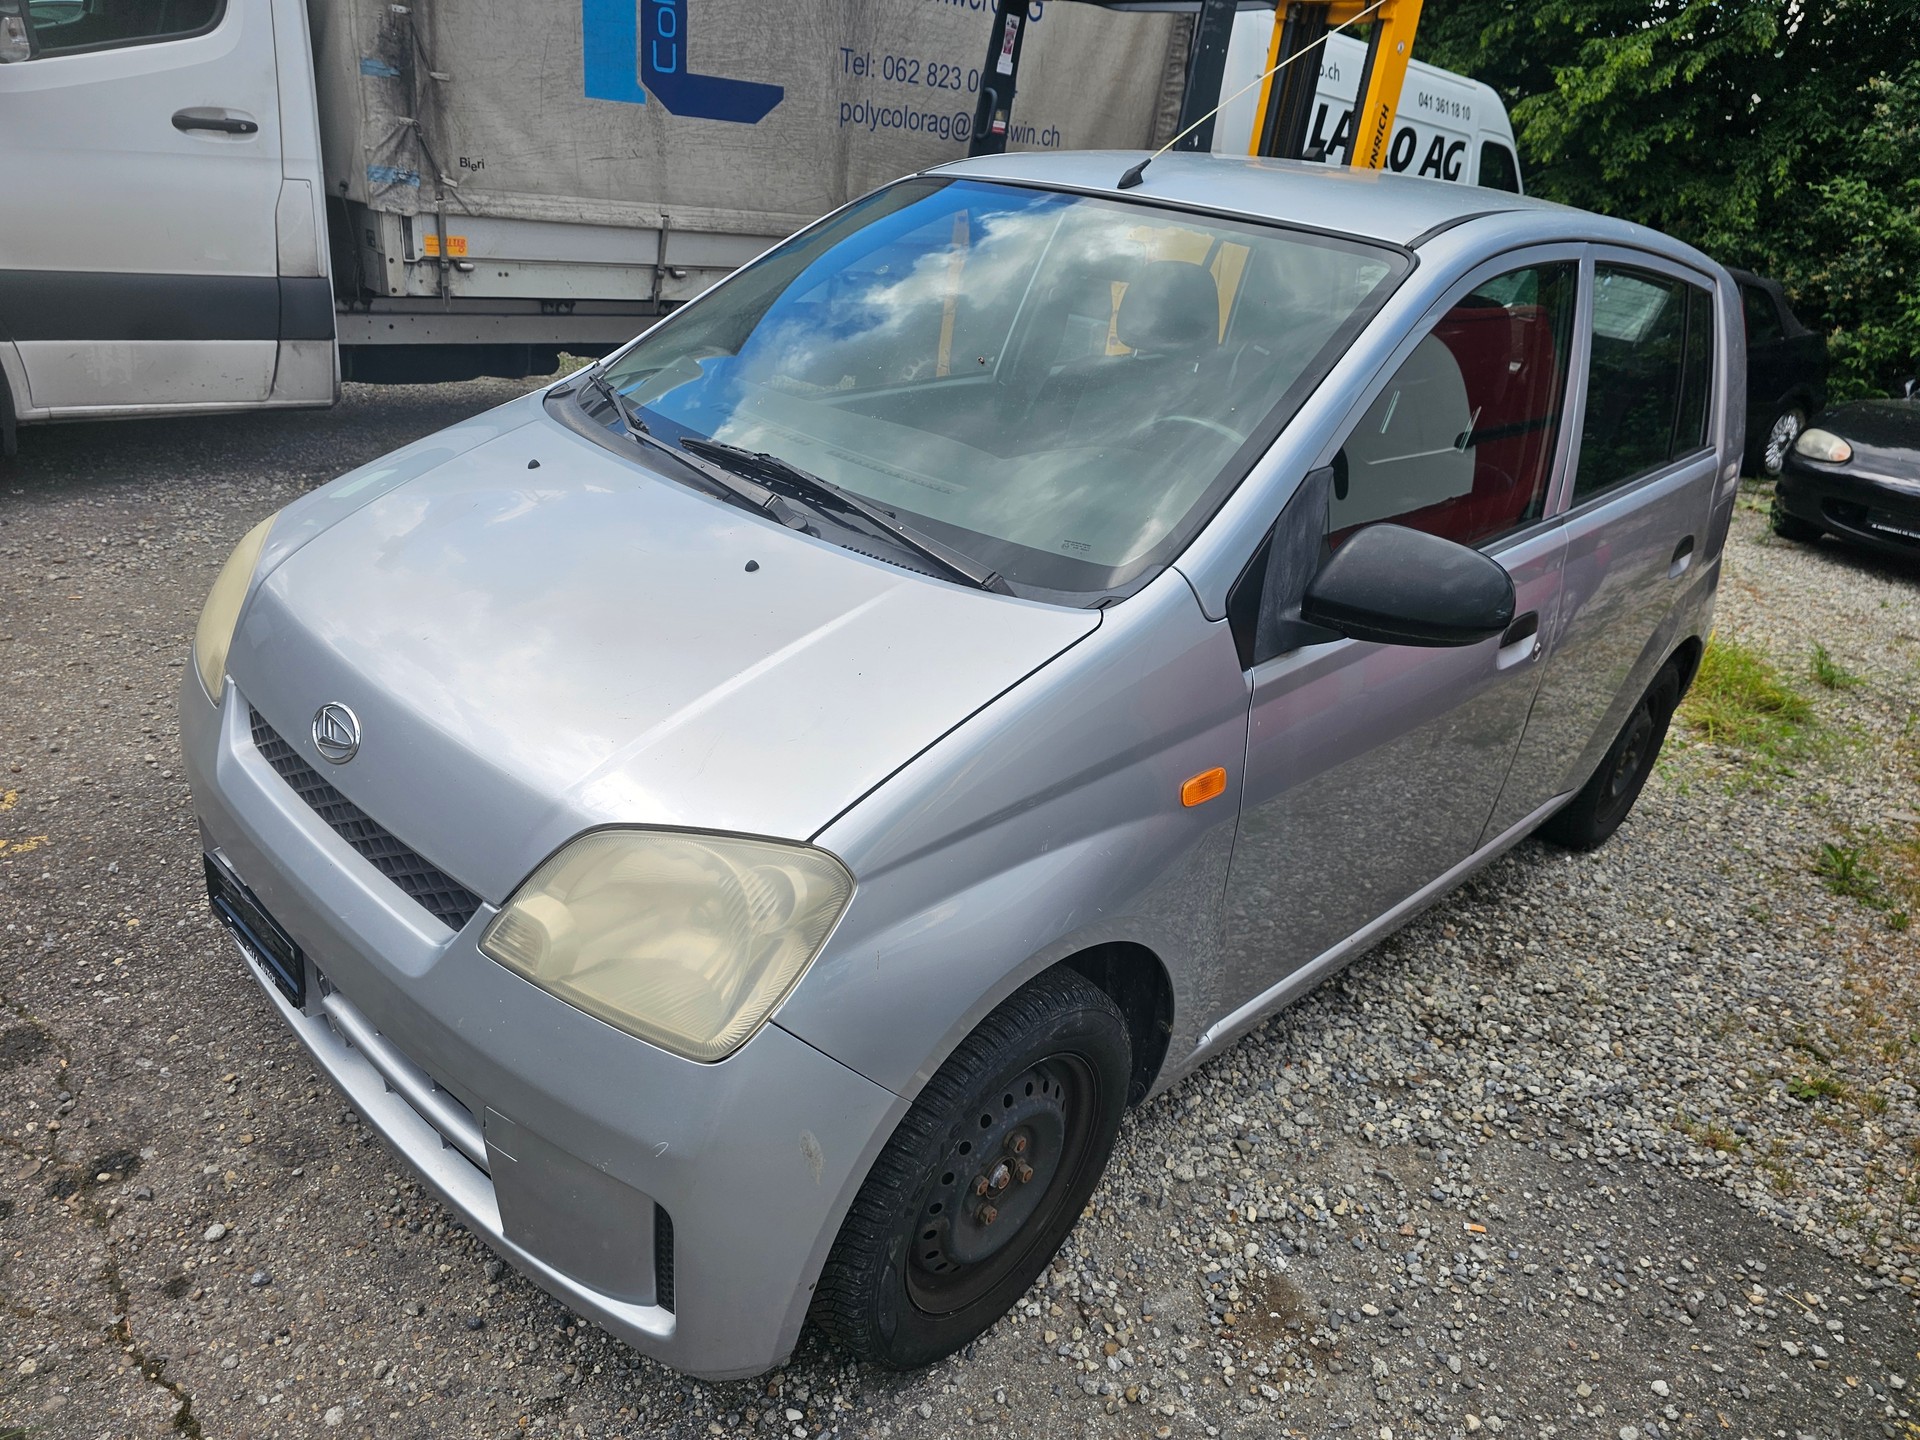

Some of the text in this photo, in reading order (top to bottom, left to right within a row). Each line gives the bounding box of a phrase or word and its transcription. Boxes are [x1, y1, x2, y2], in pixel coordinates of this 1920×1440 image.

[840, 47, 984, 93] Tel: 062 823 0
[1418, 91, 1471, 121] 041 361 18 10
[459, 156, 485, 172] Bieri
[1418, 134, 1467, 182] AG
